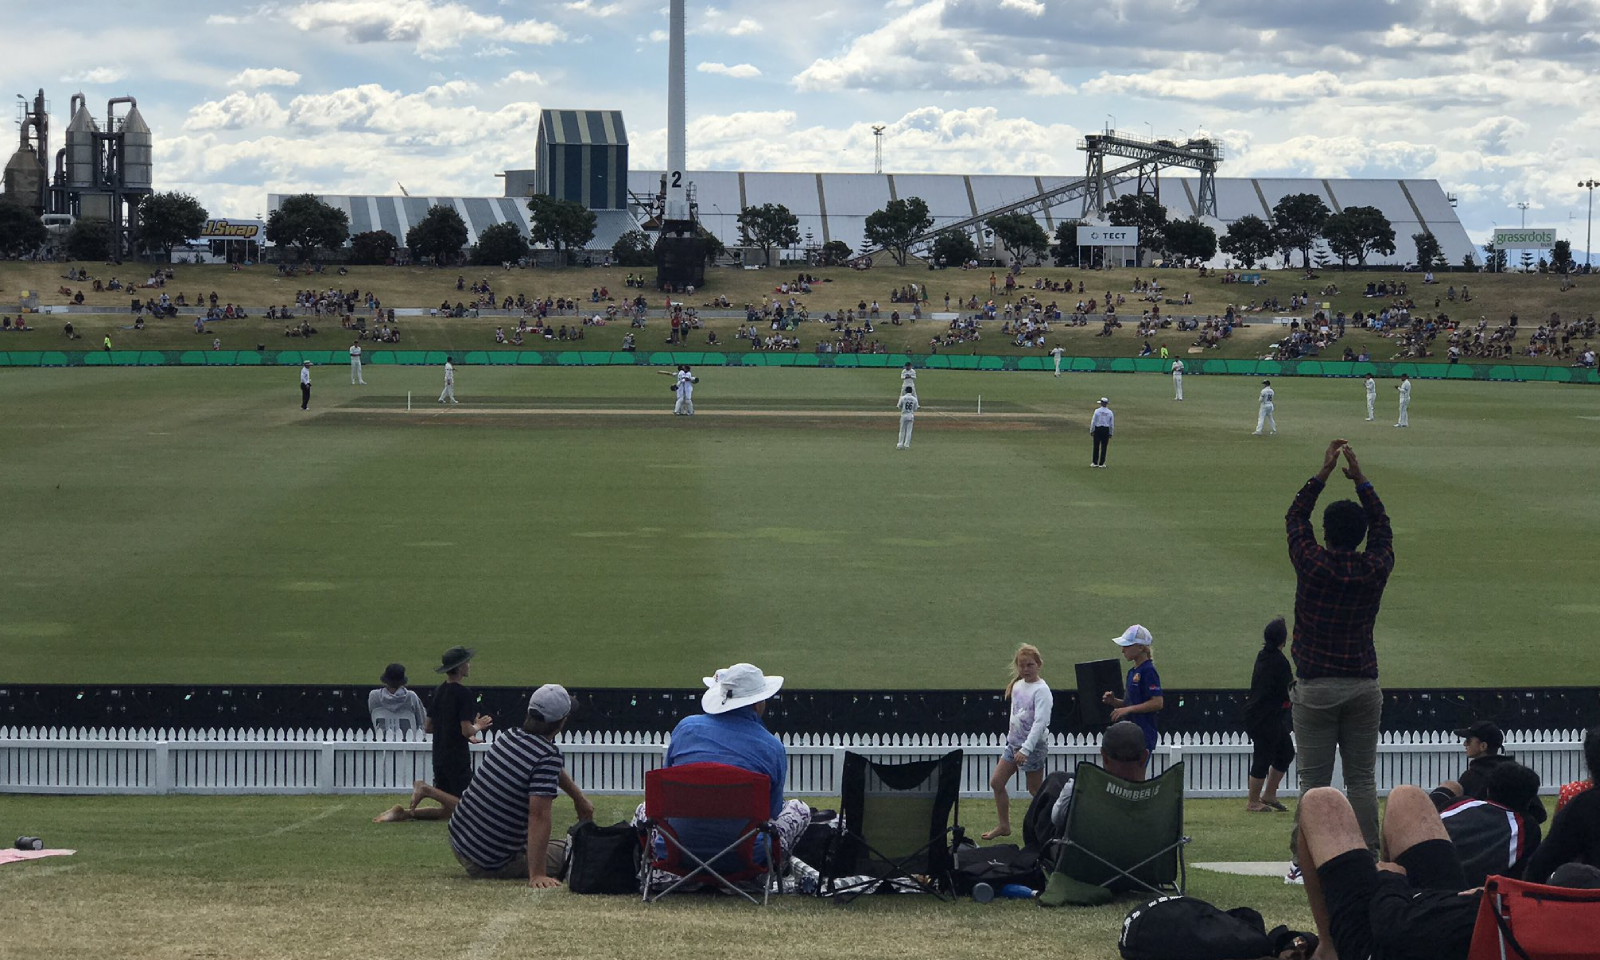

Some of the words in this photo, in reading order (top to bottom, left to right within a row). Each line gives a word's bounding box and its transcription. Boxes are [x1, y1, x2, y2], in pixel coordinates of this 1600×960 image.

[672, 171, 681, 188] 2
[202, 220, 258, 238] J.Swap
[905, 401, 913, 410] 66
